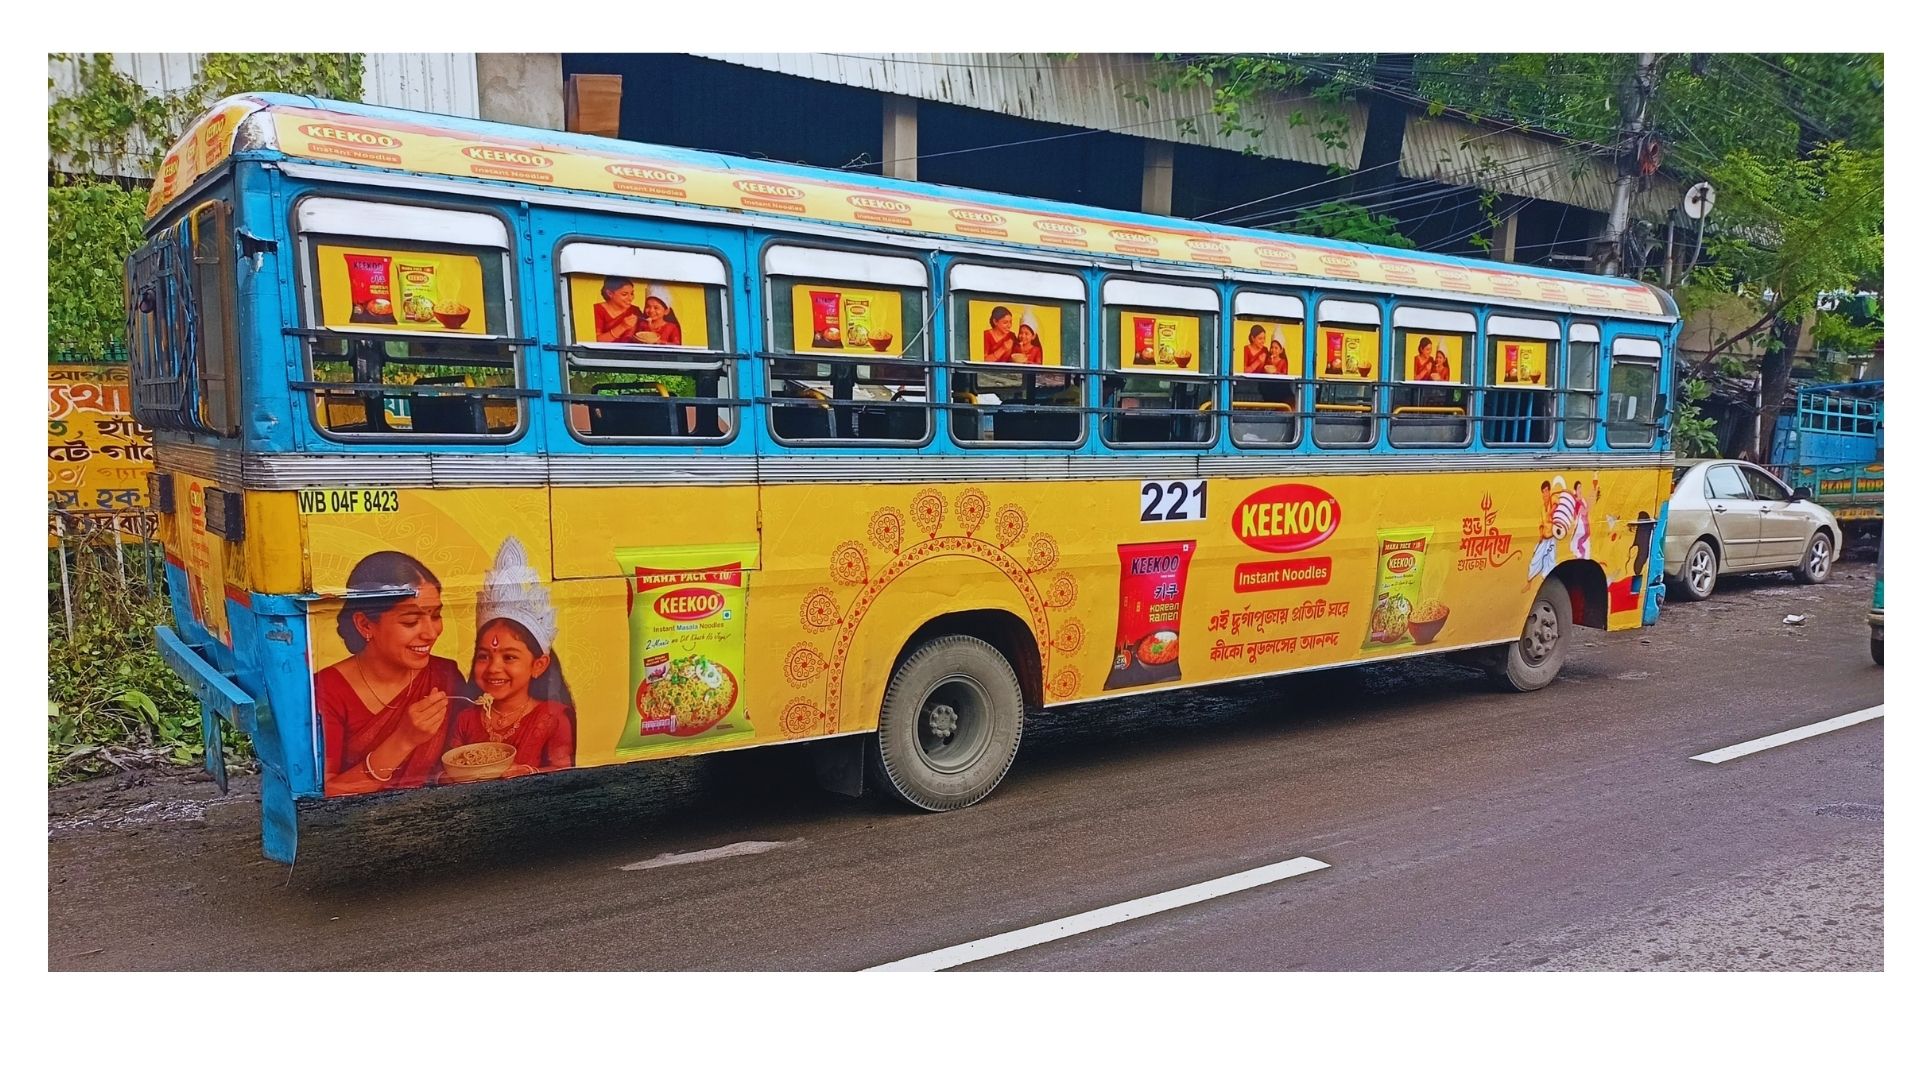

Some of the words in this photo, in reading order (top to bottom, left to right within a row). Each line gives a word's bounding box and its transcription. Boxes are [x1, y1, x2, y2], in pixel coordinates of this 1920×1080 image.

[308, 126, 393, 147] KEEKOO
[312, 145, 351, 157] Instant
[353, 151, 398, 162] Noodles
[469, 148, 546, 167] KEEKOO
[611, 165, 679, 183] KEEKOO
[738, 181, 798, 198] KEEKOO
[851, 196, 907, 213] KEEKOO
[299, 491, 327, 513] WB
[331, 491, 360, 513] 04F
[363, 491, 399, 512] 8423
[1141, 481, 1208, 521] 221
[1241, 499, 1332, 538] KEEKOO
[1131, 555, 1180, 575] KEEKOO
[1388, 557, 1414, 569] KEEKOO
[643, 574, 677, 584] MAHA
[681, 571, 707, 582] PACK
[1239, 572, 1280, 586] Instant
[1282, 565, 1328, 582] Noodles
[659, 594, 719, 615] KEEKOO
[1208, 609, 1231, 632] এই
[1291, 598, 1327, 622] প্রতিটি
[1327, 601, 1350, 618] ঘরে
[653, 624, 675, 633] Instant
[699, 621, 725, 630] Noodles
[1209, 639, 1245, 662] কীকো
